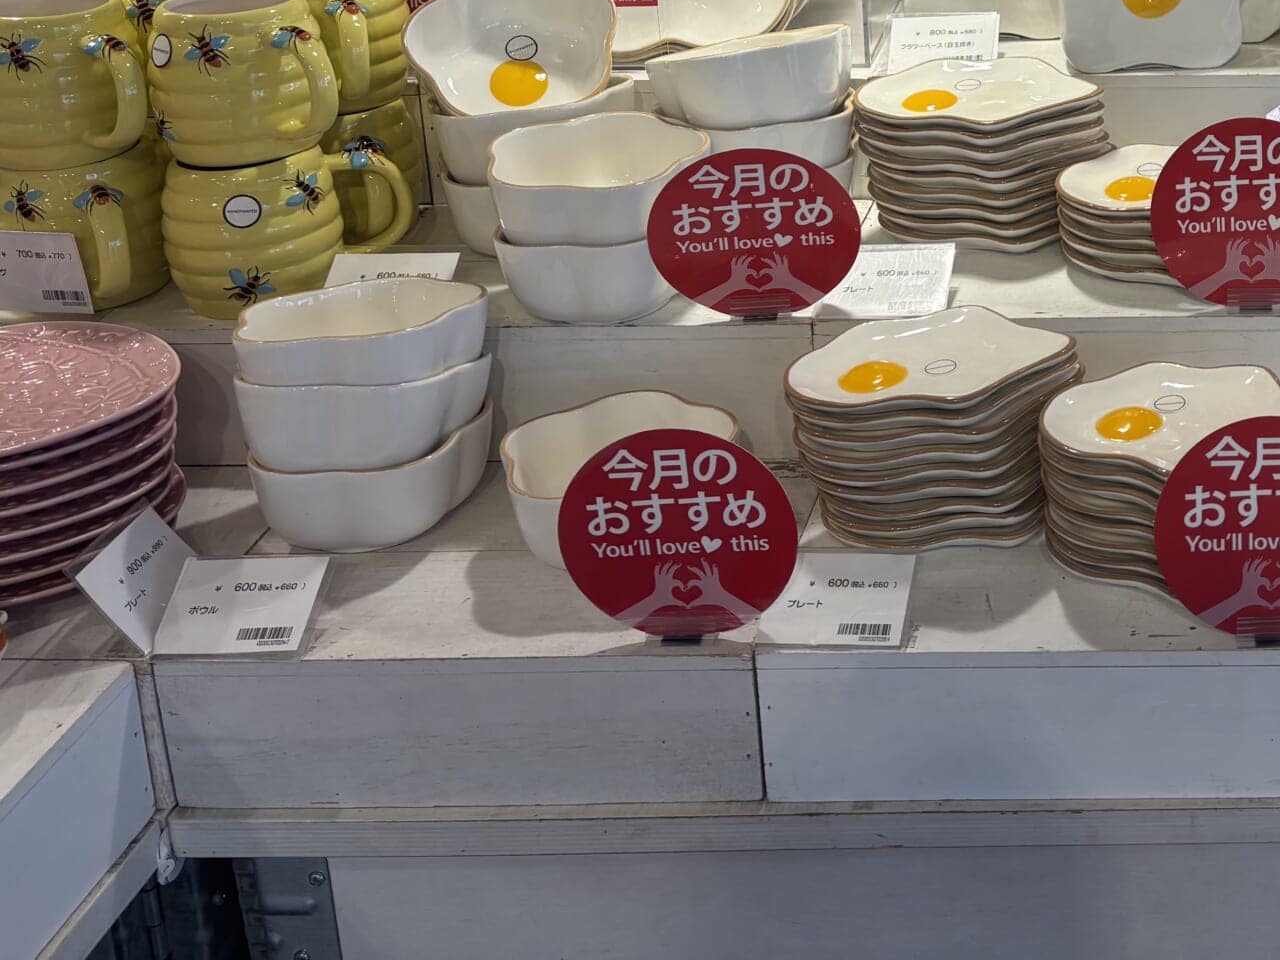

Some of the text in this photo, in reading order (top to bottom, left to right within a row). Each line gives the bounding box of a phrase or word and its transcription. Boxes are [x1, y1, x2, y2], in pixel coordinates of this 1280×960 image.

[688, 163, 810, 200] 今月の
[672, 196, 834, 236] おすすめ
[1177, 216, 1226, 234] You'll
[1231, 216, 1268, 232] love
[676, 232, 835, 253] You'll love this
[16, 249, 33, 258] 700
[876, 269, 895, 277] 600
[601, 449, 737, 491] 今月の
[586, 490, 767, 536] おすすめ
[592, 535, 770, 558] You'll love this
[1185, 532, 1242, 552] You'll
[126, 559, 143, 575] 900
[234, 582, 256, 591] 600
[828, 578, 849, 588] 600
[124, 589, 148, 611] プレート
[787, 600, 824, 608] プレート
[188, 606, 219, 615] ボウル
